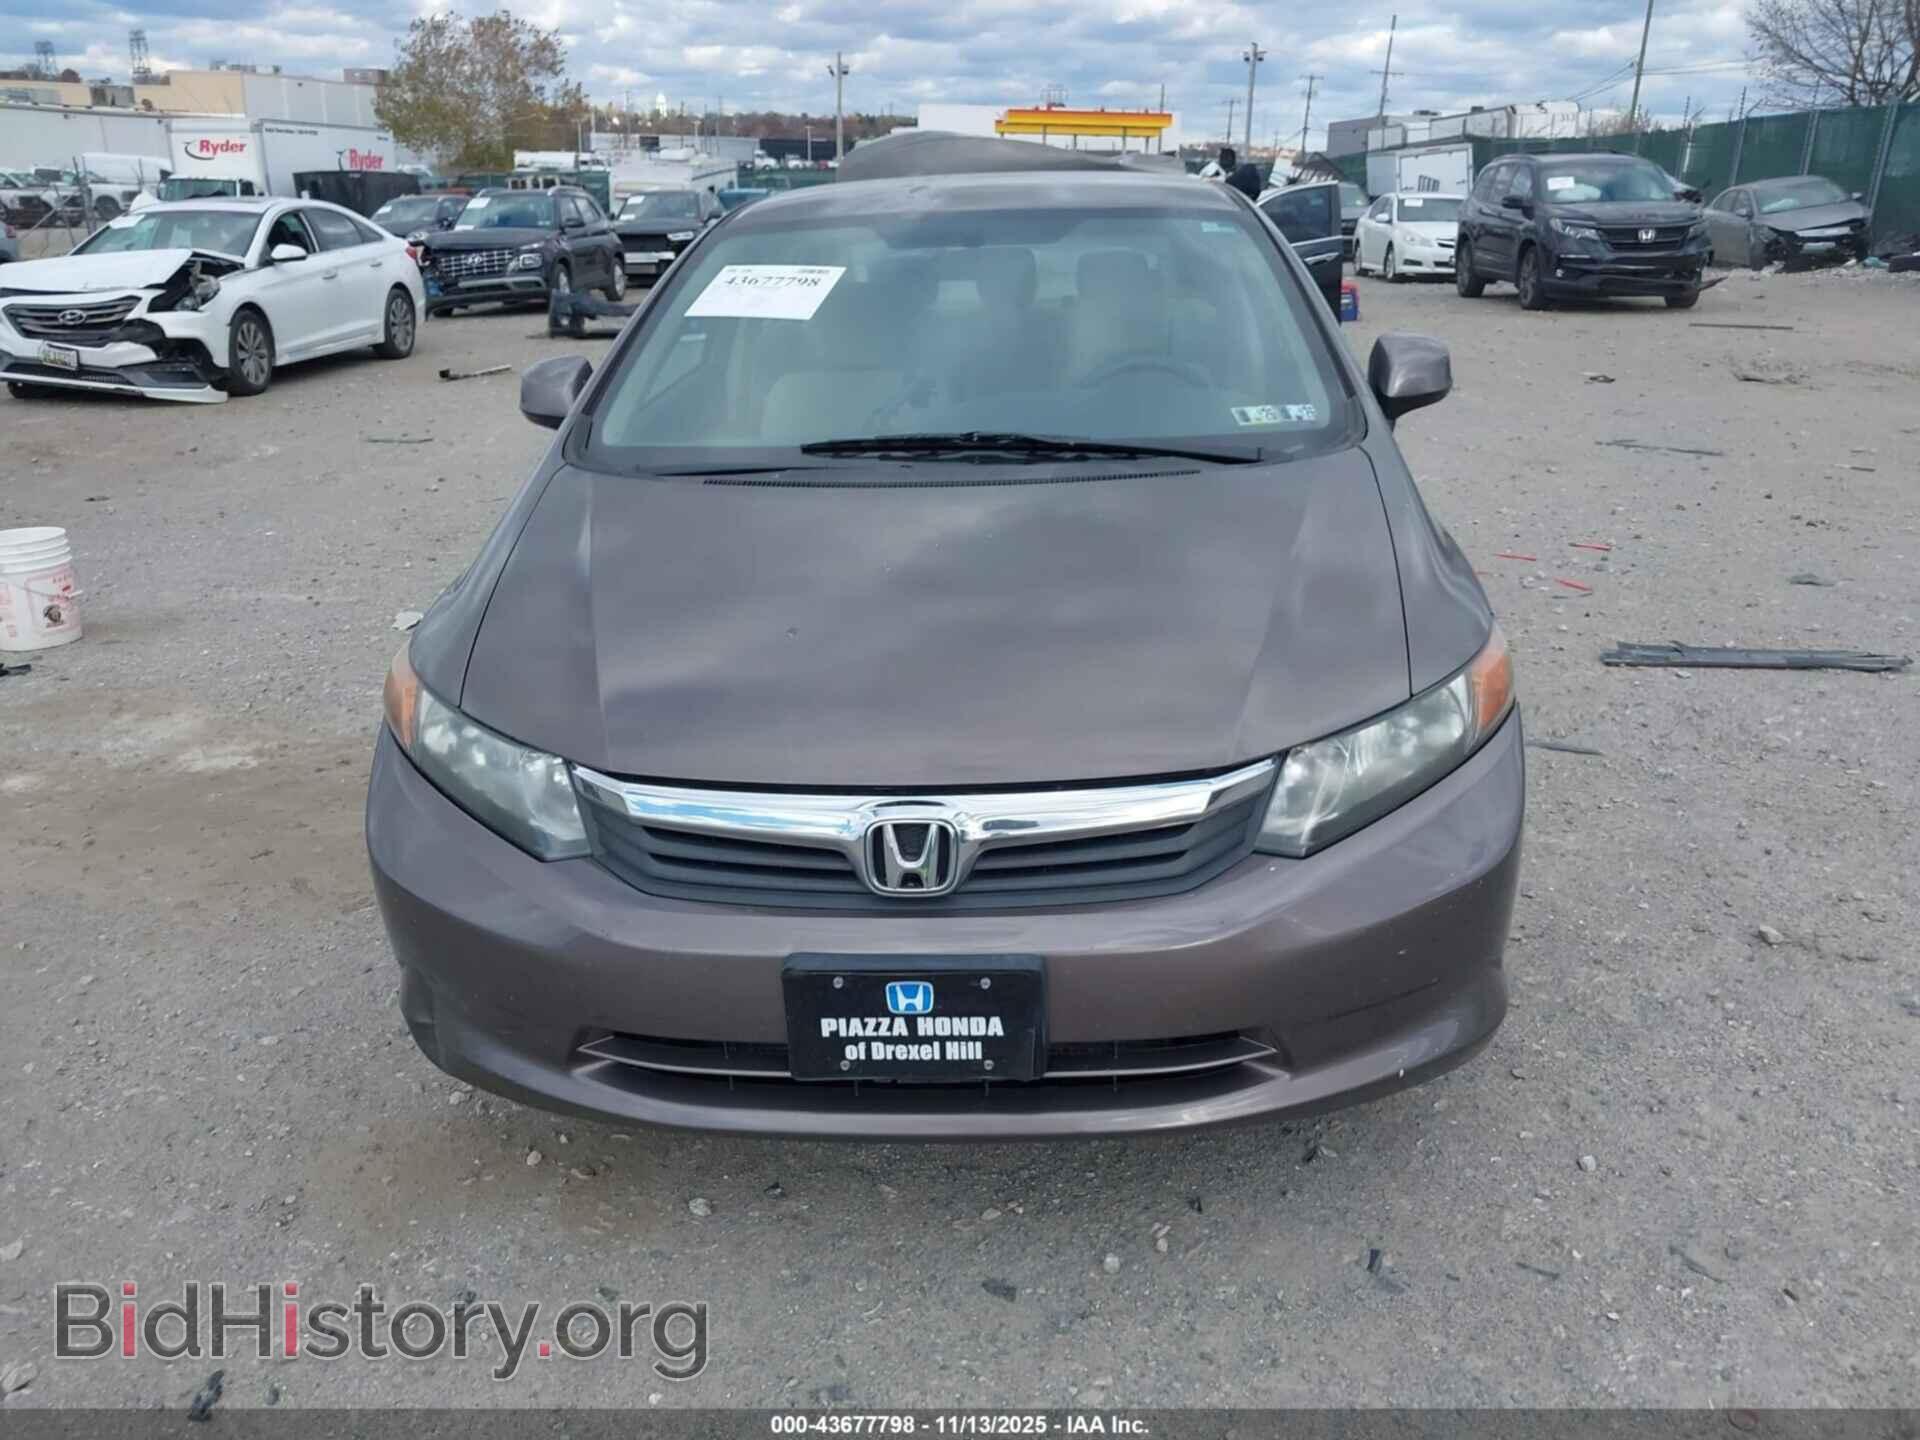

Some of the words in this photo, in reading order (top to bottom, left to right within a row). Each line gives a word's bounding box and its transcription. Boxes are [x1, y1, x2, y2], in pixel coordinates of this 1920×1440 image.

[200, 139, 247, 156] Ryder
[349, 149, 384, 171] Ryder
[726, 275, 822, 287] 43677798
[820, 1018, 908, 1037] PIAZZA
[917, 1016, 1004, 1036] HONDA
[844, 1041, 866, 1060] of
[871, 1041, 940, 1060] Drexel
[946, 1041, 983, 1060] Hill
